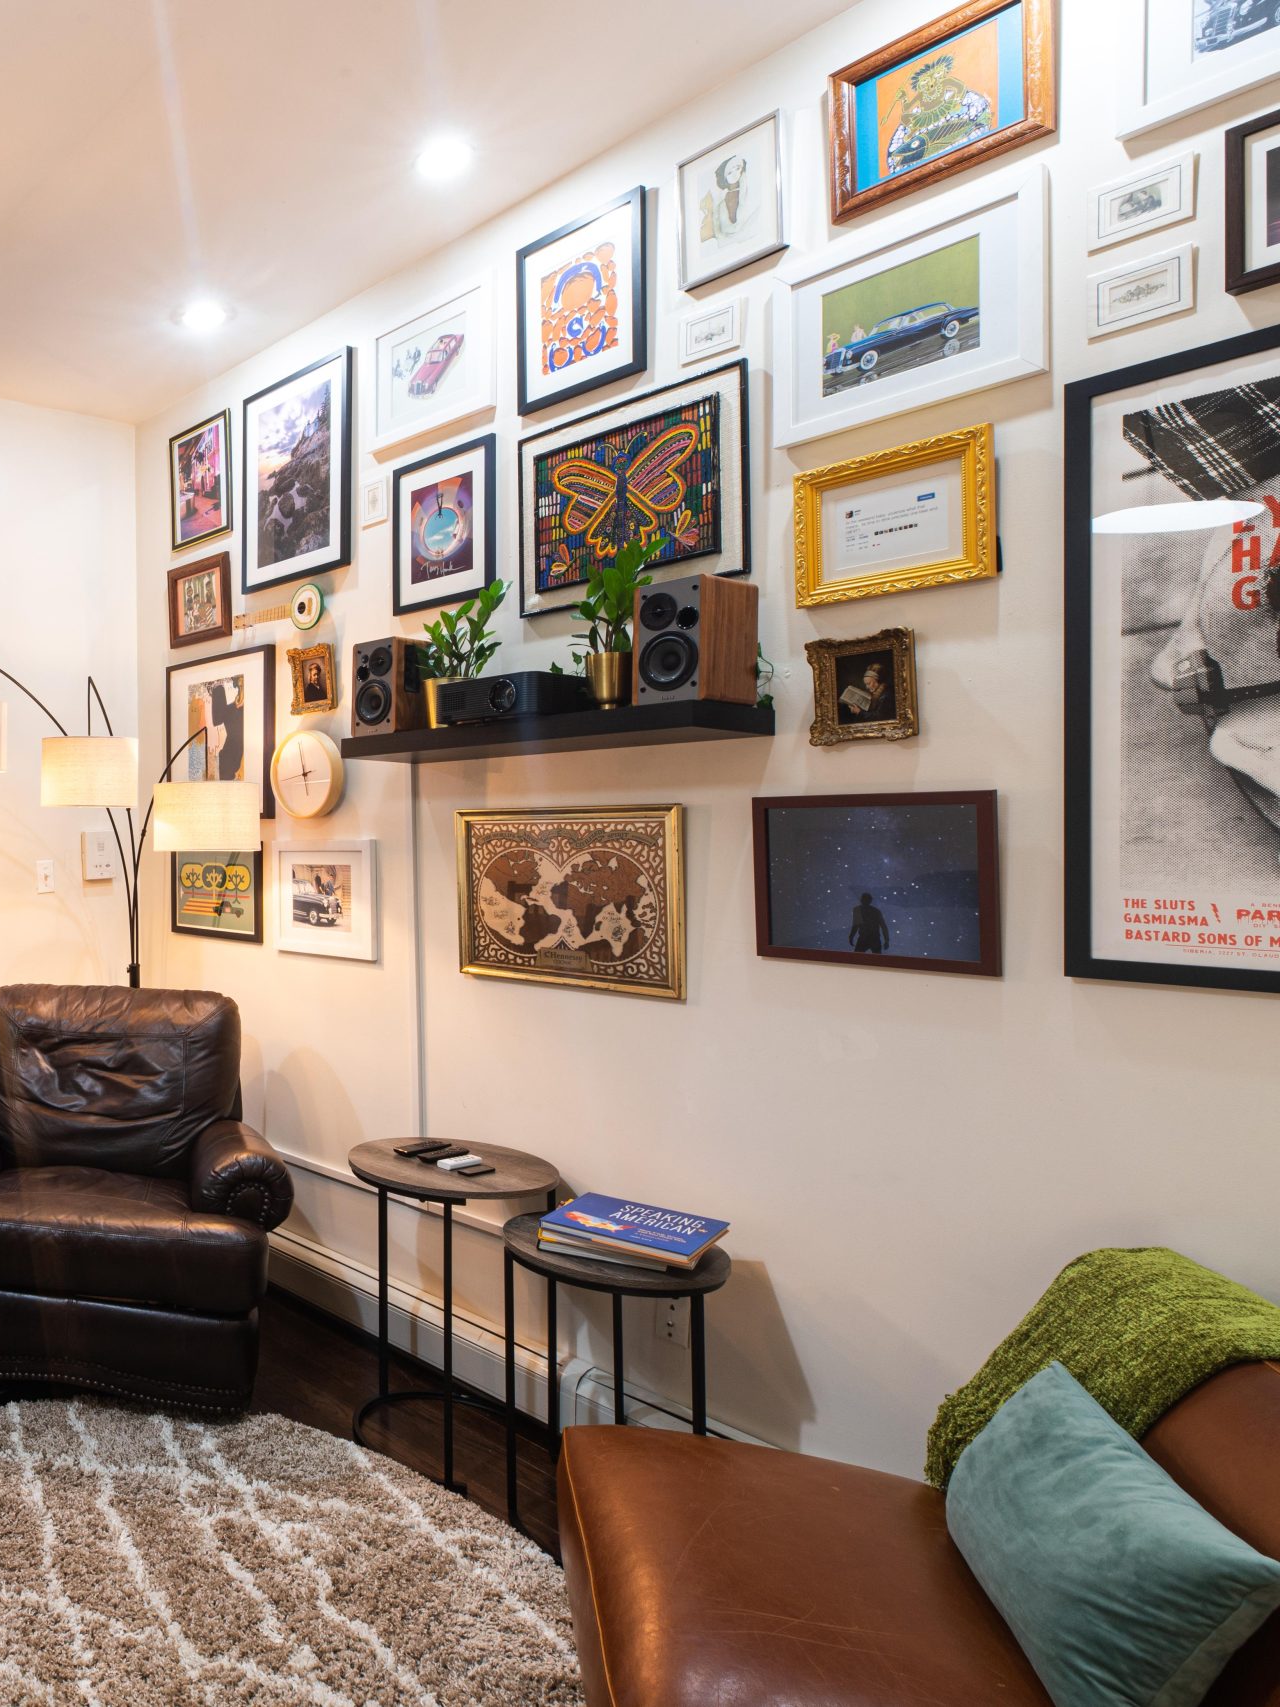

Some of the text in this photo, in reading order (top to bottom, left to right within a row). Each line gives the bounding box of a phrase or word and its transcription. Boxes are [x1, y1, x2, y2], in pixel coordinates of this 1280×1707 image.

[1123, 898, 1195, 911] THE SLUTS
[1123, 913, 1209, 927] GASMIASMA
[1125, 928, 1191, 943] BASTARD
[1198, 932, 1237, 946] SONS
[1244, 935, 1263, 947] OF
[609, 1211, 697, 1236] AMERICAN
[620, 1204, 706, 1229] SPEAKING
